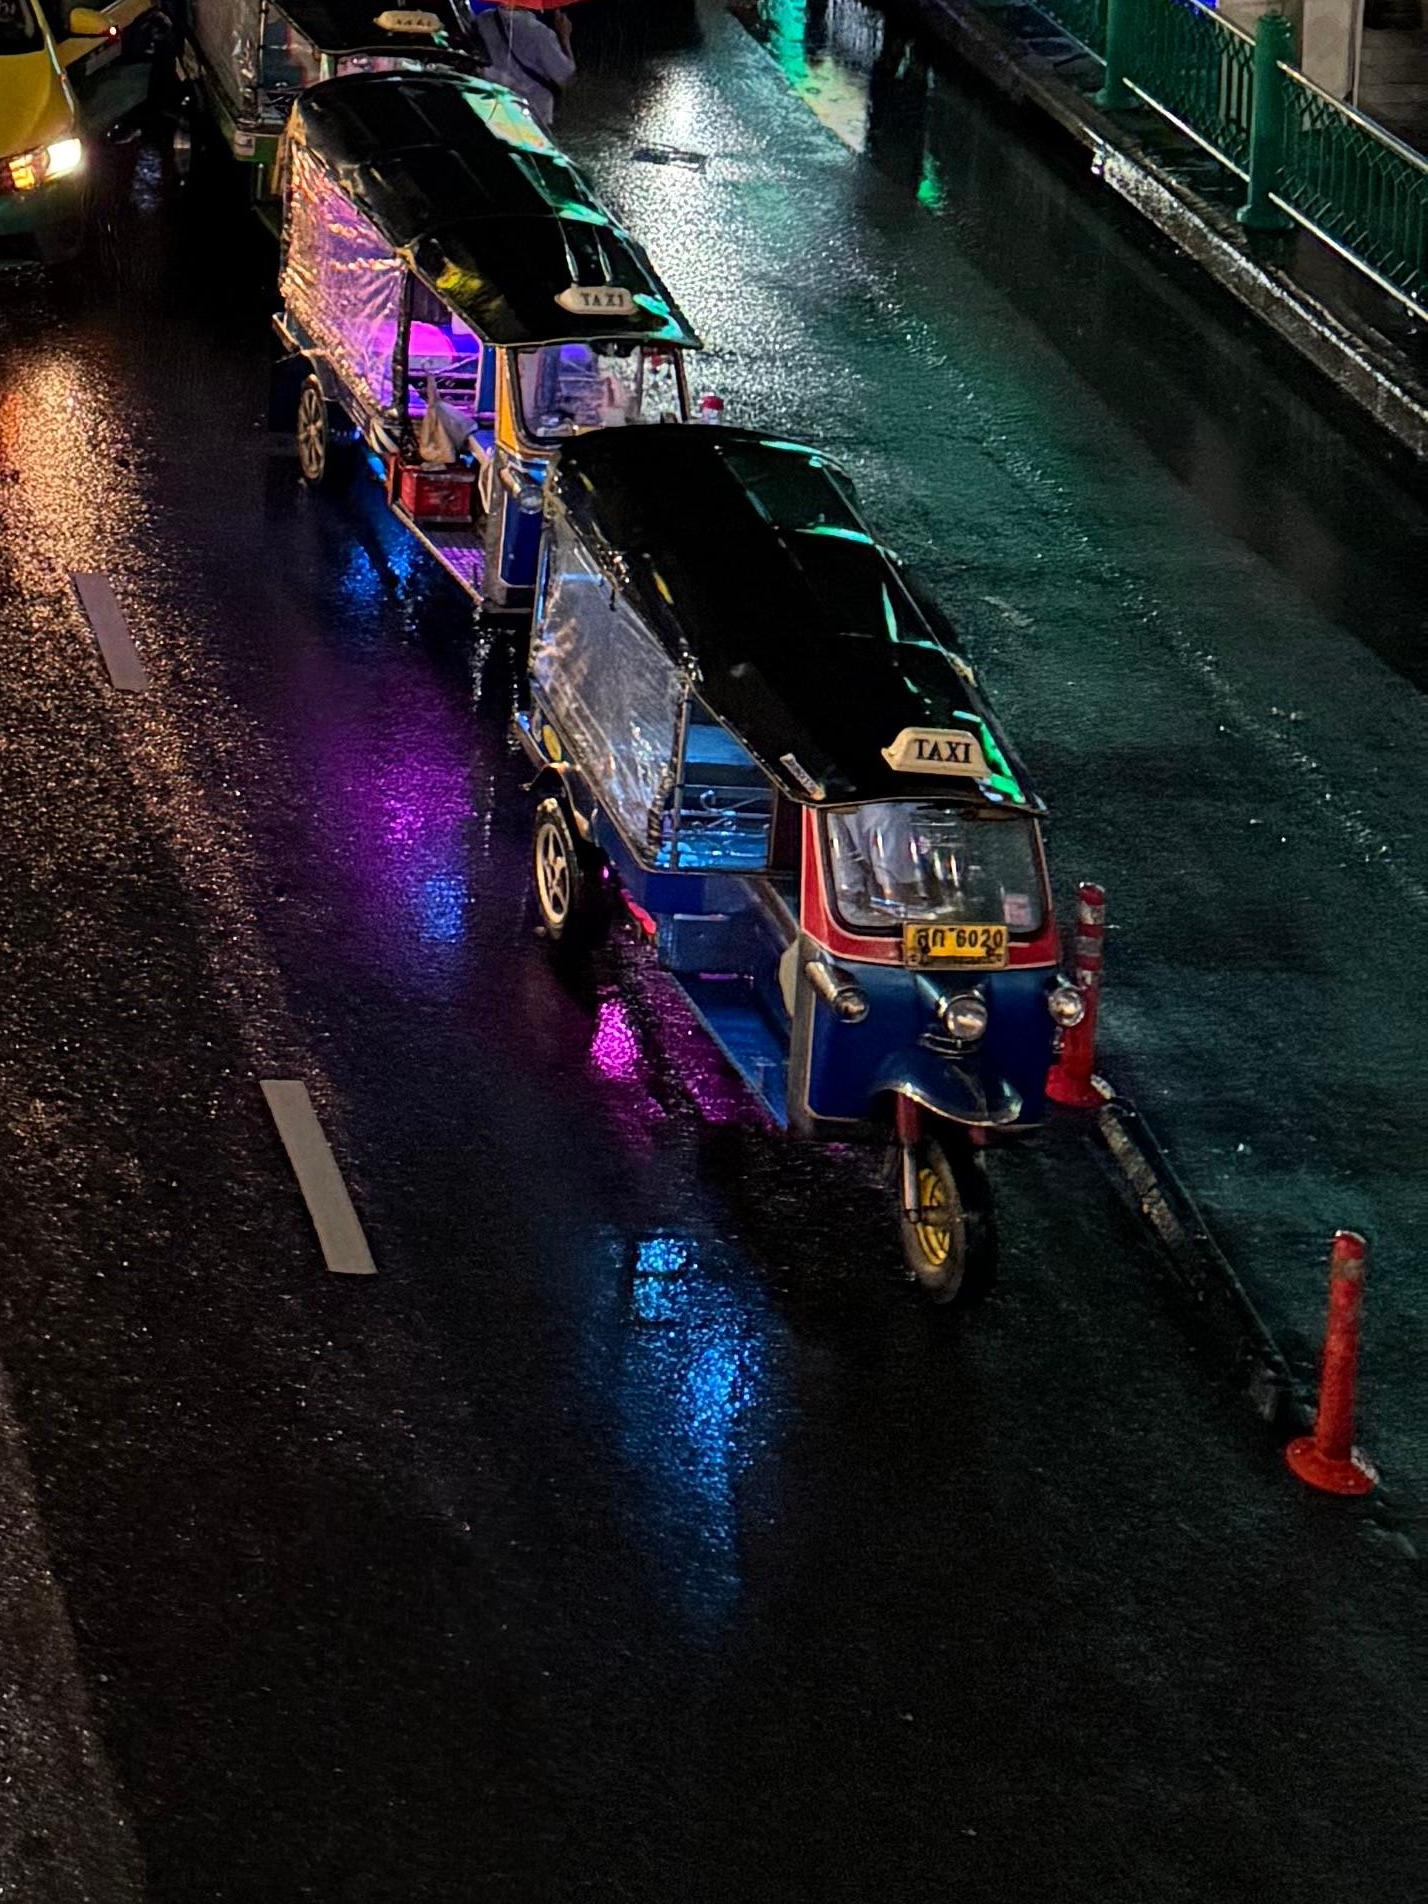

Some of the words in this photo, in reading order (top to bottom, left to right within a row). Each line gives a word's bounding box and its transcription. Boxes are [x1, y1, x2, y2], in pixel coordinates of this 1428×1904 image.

[581, 293, 624, 307] TAXI
[915, 740, 972, 765] TAXI
[955, 929, 1004, 949] 6020
